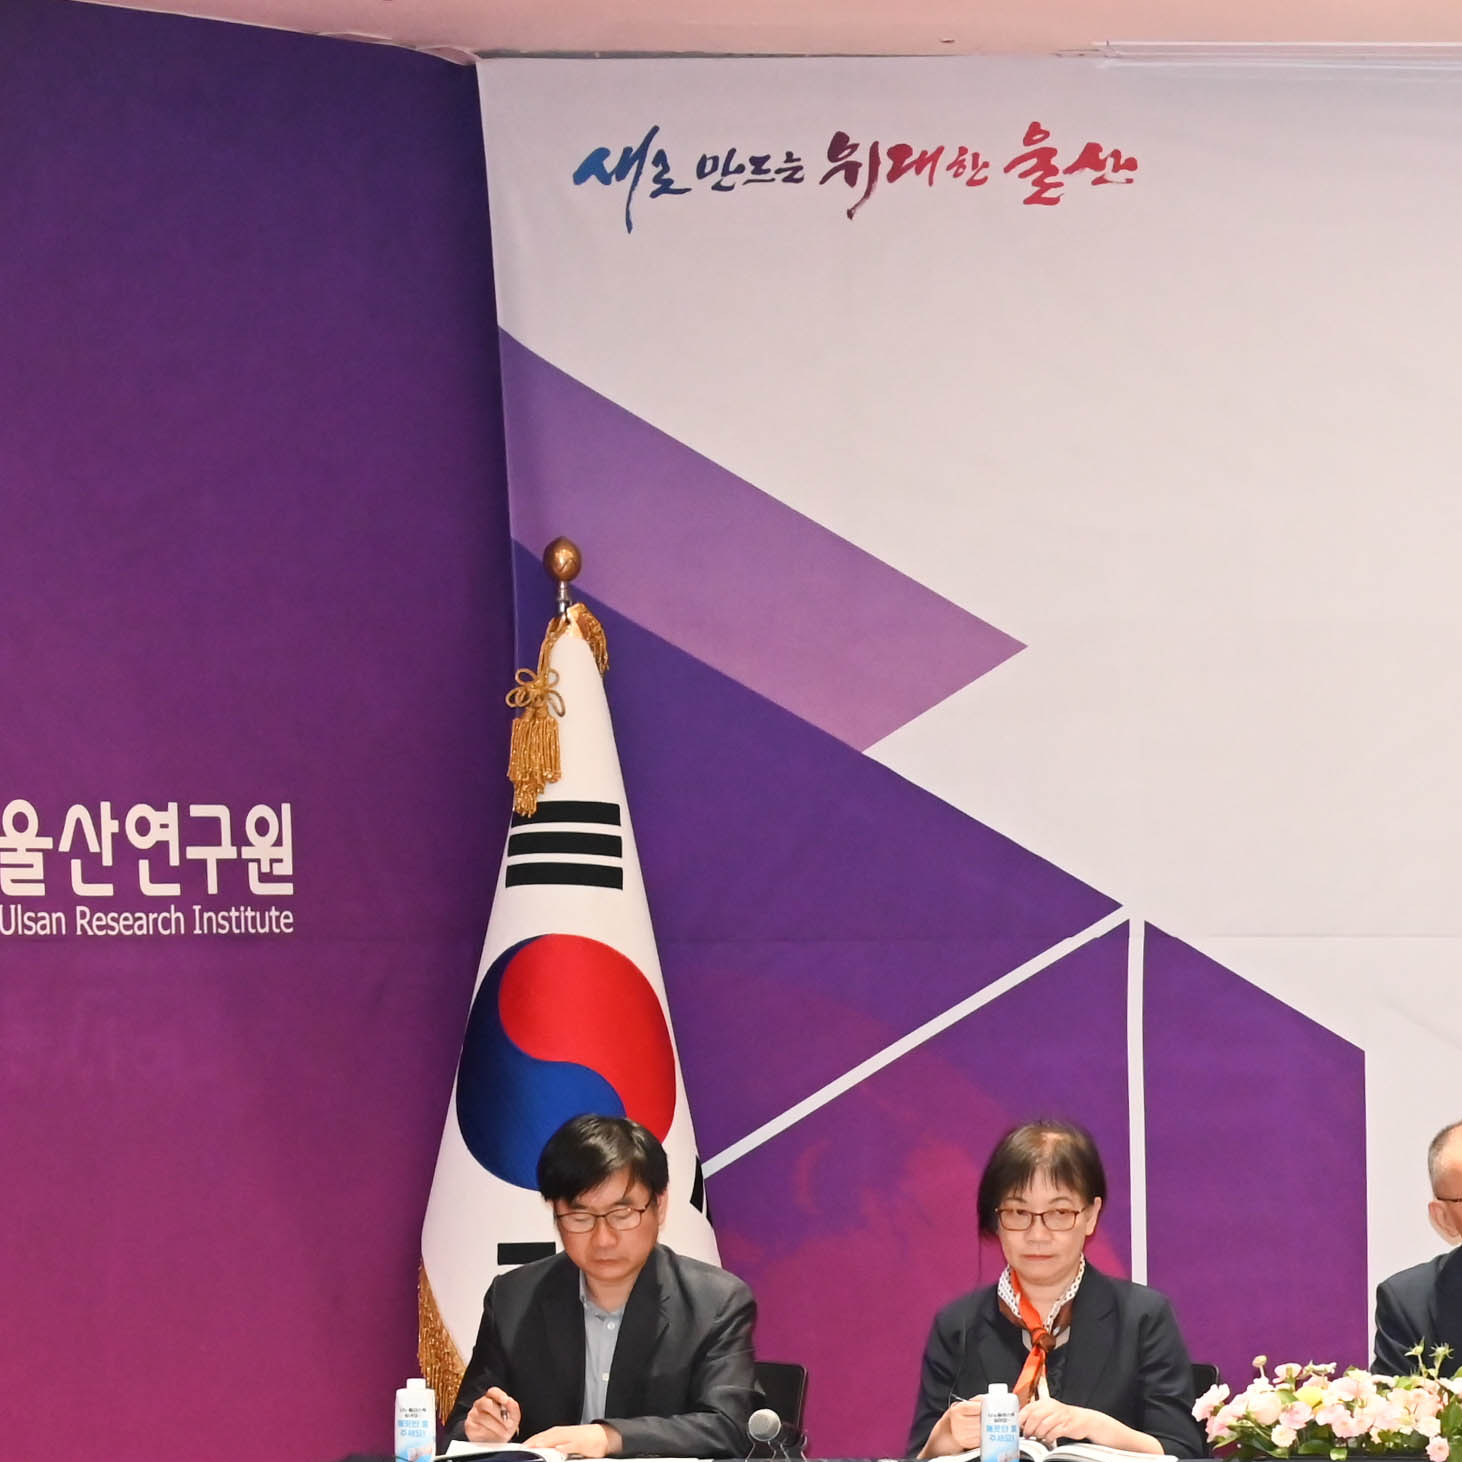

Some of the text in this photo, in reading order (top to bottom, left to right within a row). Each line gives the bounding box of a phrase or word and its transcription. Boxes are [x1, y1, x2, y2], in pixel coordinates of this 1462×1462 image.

[573, 121, 1138, 233] 새로 만드는 위대한 울산
[0, 799, 293, 896] 울산연구원
[0, 904, 293, 935] Ulsan Research Institute
